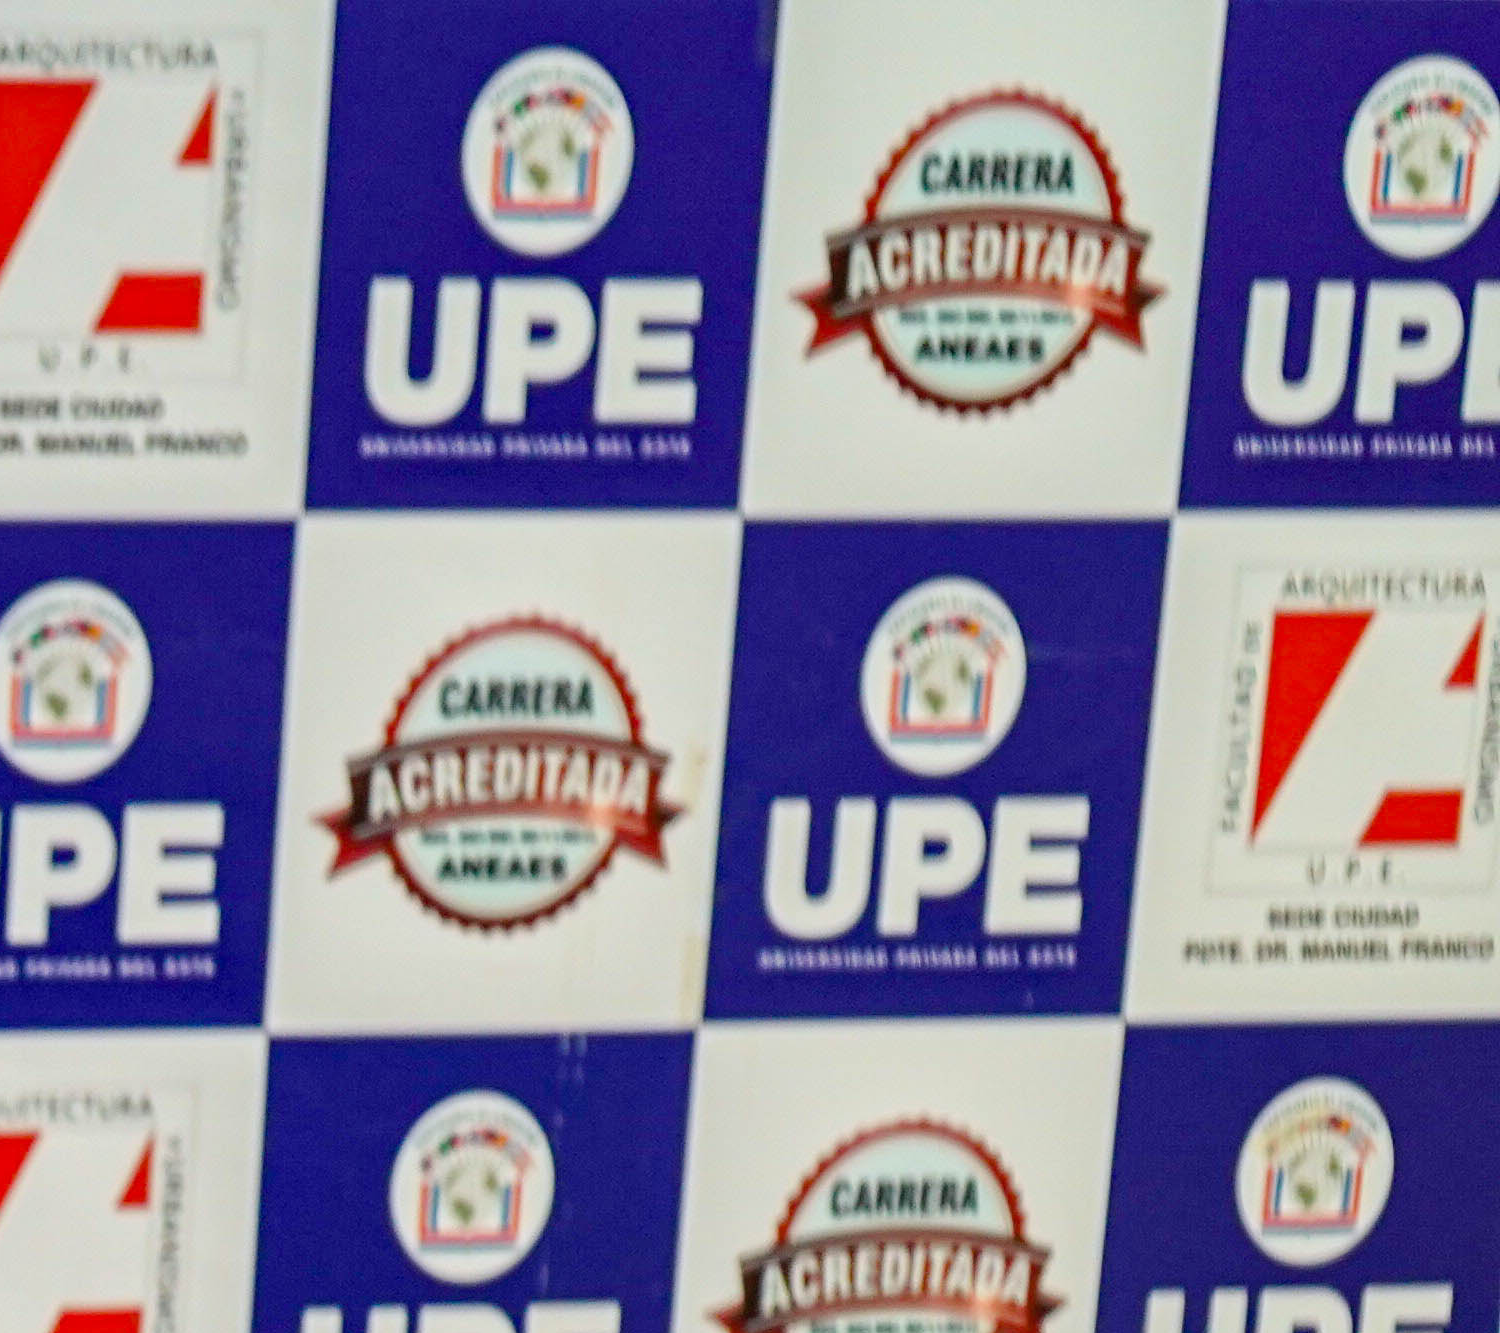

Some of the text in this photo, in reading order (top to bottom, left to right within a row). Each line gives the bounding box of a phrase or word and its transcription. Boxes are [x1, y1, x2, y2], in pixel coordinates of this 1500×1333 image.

[919, 153, 1077, 195] CARRERA
[845, 224, 1132, 302] ACREDITADA
[363, 275, 705, 427] UPE
[143, 432, 248, 457] FRANCO
[1279, 572, 1487, 600] ARQUITECTURA
[438, 678, 595, 718] CARRERA
[366, 746, 651, 823] ACREDITADA
[762, 794, 1091, 941] UPE
[1399, 935, 1497, 960] FRANCO
[829, 1177, 981, 1217] CARRERA
[758, 1241, 1034, 1318] ACREDITADA
